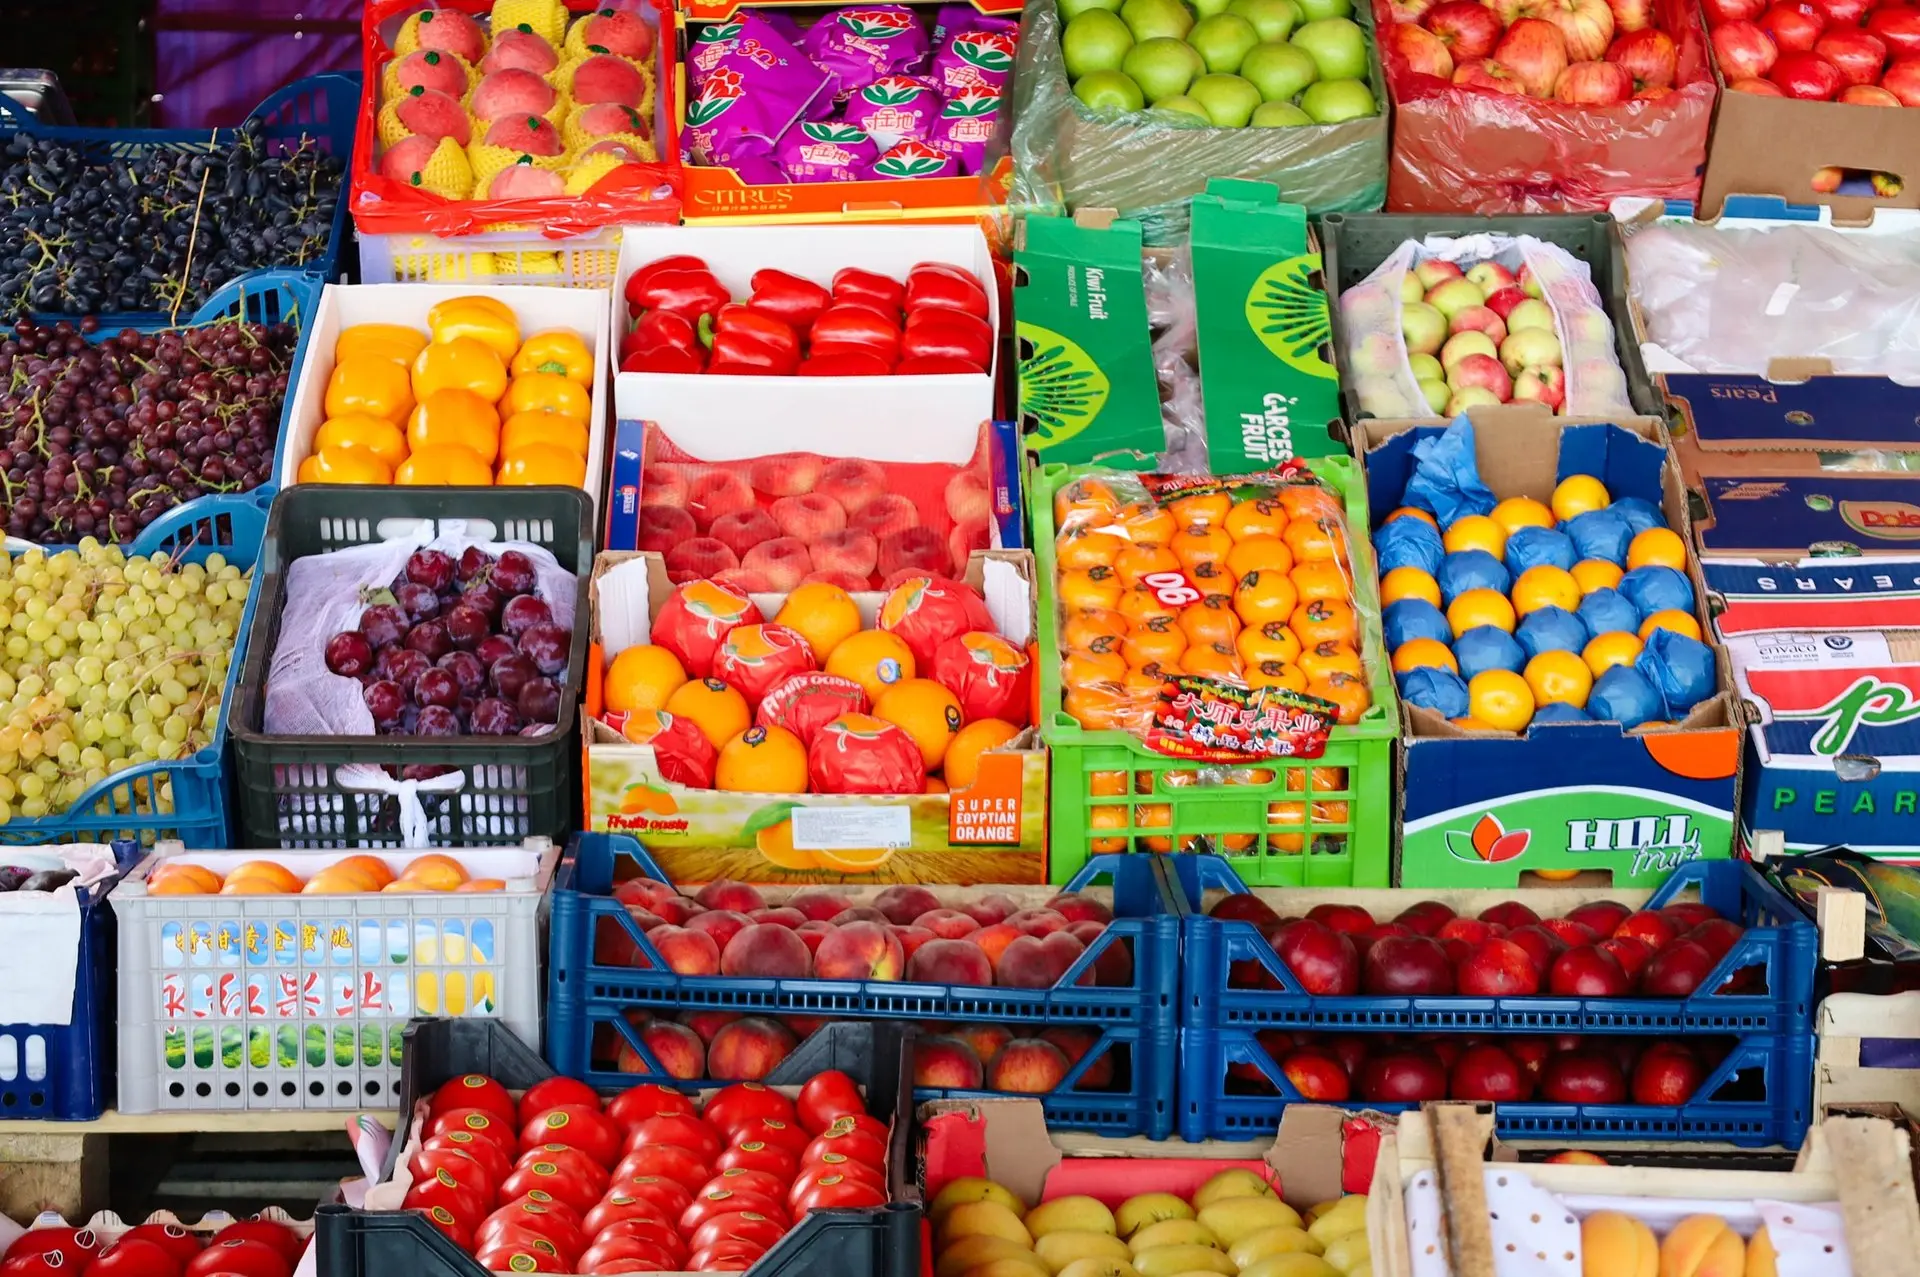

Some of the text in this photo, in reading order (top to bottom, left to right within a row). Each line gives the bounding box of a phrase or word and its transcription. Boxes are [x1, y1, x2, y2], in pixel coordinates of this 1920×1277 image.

[694, 188, 793, 205] CITRUS
[1085, 267, 1109, 320] Kiwi Fruit
[1710, 388, 1778, 403] Pears
[1240, 412, 1269, 462] FRUIT
[1860, 510, 1920, 526] Dole
[1759, 645, 1817, 655] envaco
[1172, 692, 1321, 735] 大师兄果业
[957, 798, 1016, 811] SUPER
[956, 812, 1016, 825] EGYPTIAN
[956, 826, 1015, 841] ORANGE
[1566, 815, 1700, 852] HILL
[1630, 840, 1702, 877] fruit
